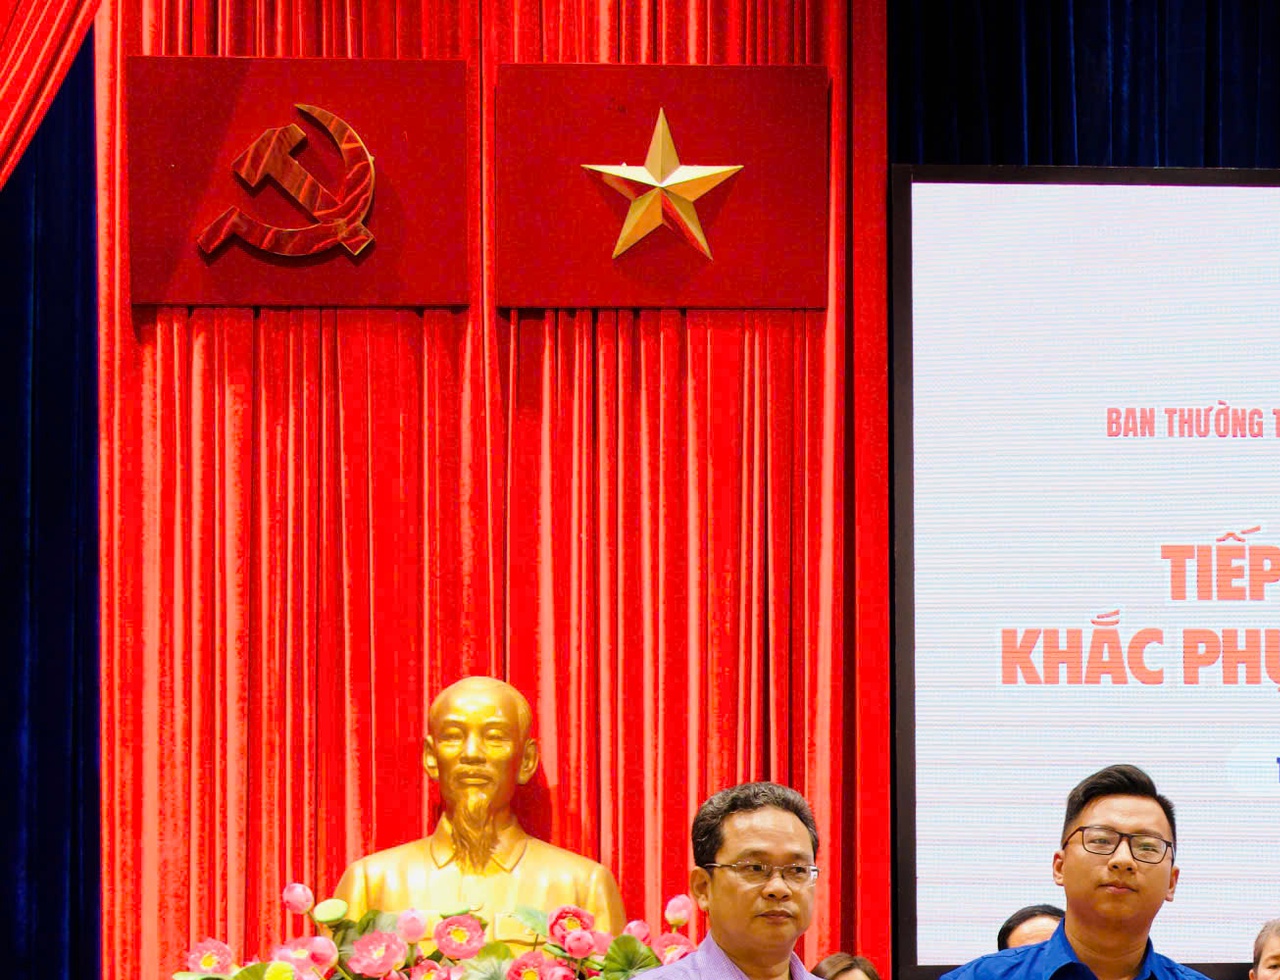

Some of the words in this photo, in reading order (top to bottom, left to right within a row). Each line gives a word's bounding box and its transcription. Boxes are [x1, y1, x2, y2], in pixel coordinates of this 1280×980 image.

[1107, 408, 1155, 438] BAN
[1165, 400, 1263, 438] THƯỜNG
[1000, 609, 1164, 686] KHẮC
